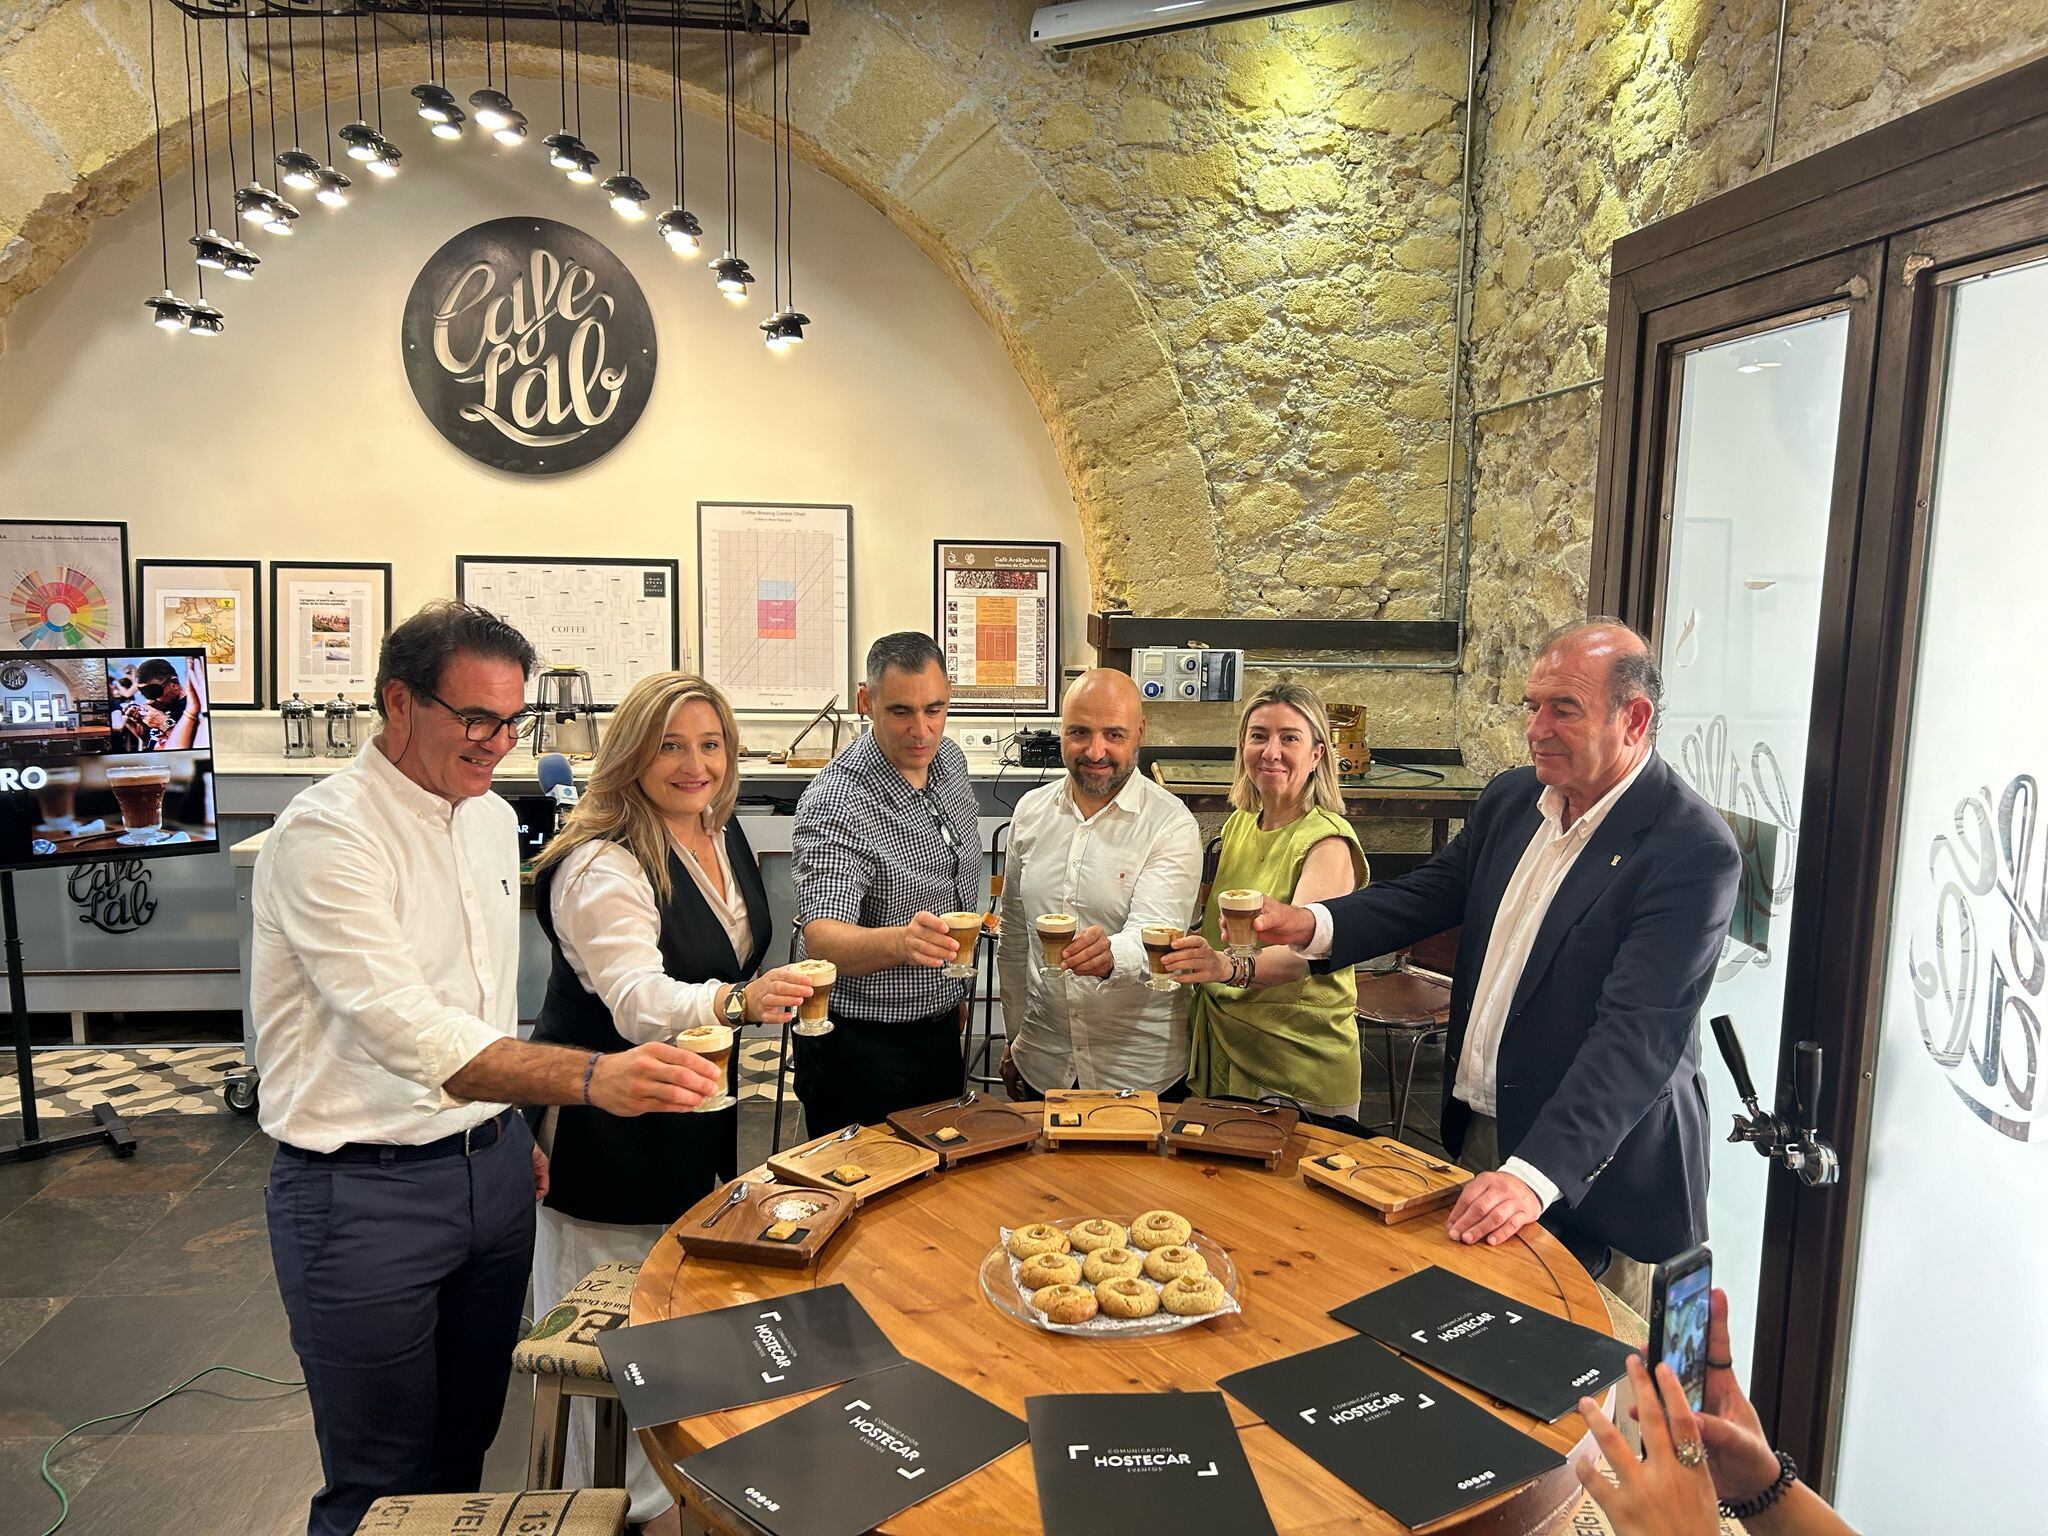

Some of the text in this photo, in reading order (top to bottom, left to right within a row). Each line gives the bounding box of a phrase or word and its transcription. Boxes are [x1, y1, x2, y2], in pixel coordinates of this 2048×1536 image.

[434, 249, 614, 373] Café
[454, 316, 627, 447] Lab
[552, 625, 588, 634] COFFEE
[12, 700, 68, 724] DEL
[78, 880, 158, 934] Lab
[754, 1324, 791, 1368] HOSTECAR
[1438, 1312, 1495, 1342] HOSTECAR
[1329, 1393, 1405, 1425] HOSTECAR
[849, 1416, 920, 1461] HOSTECAR
[1094, 1454, 1191, 1467] HOSTECAR
